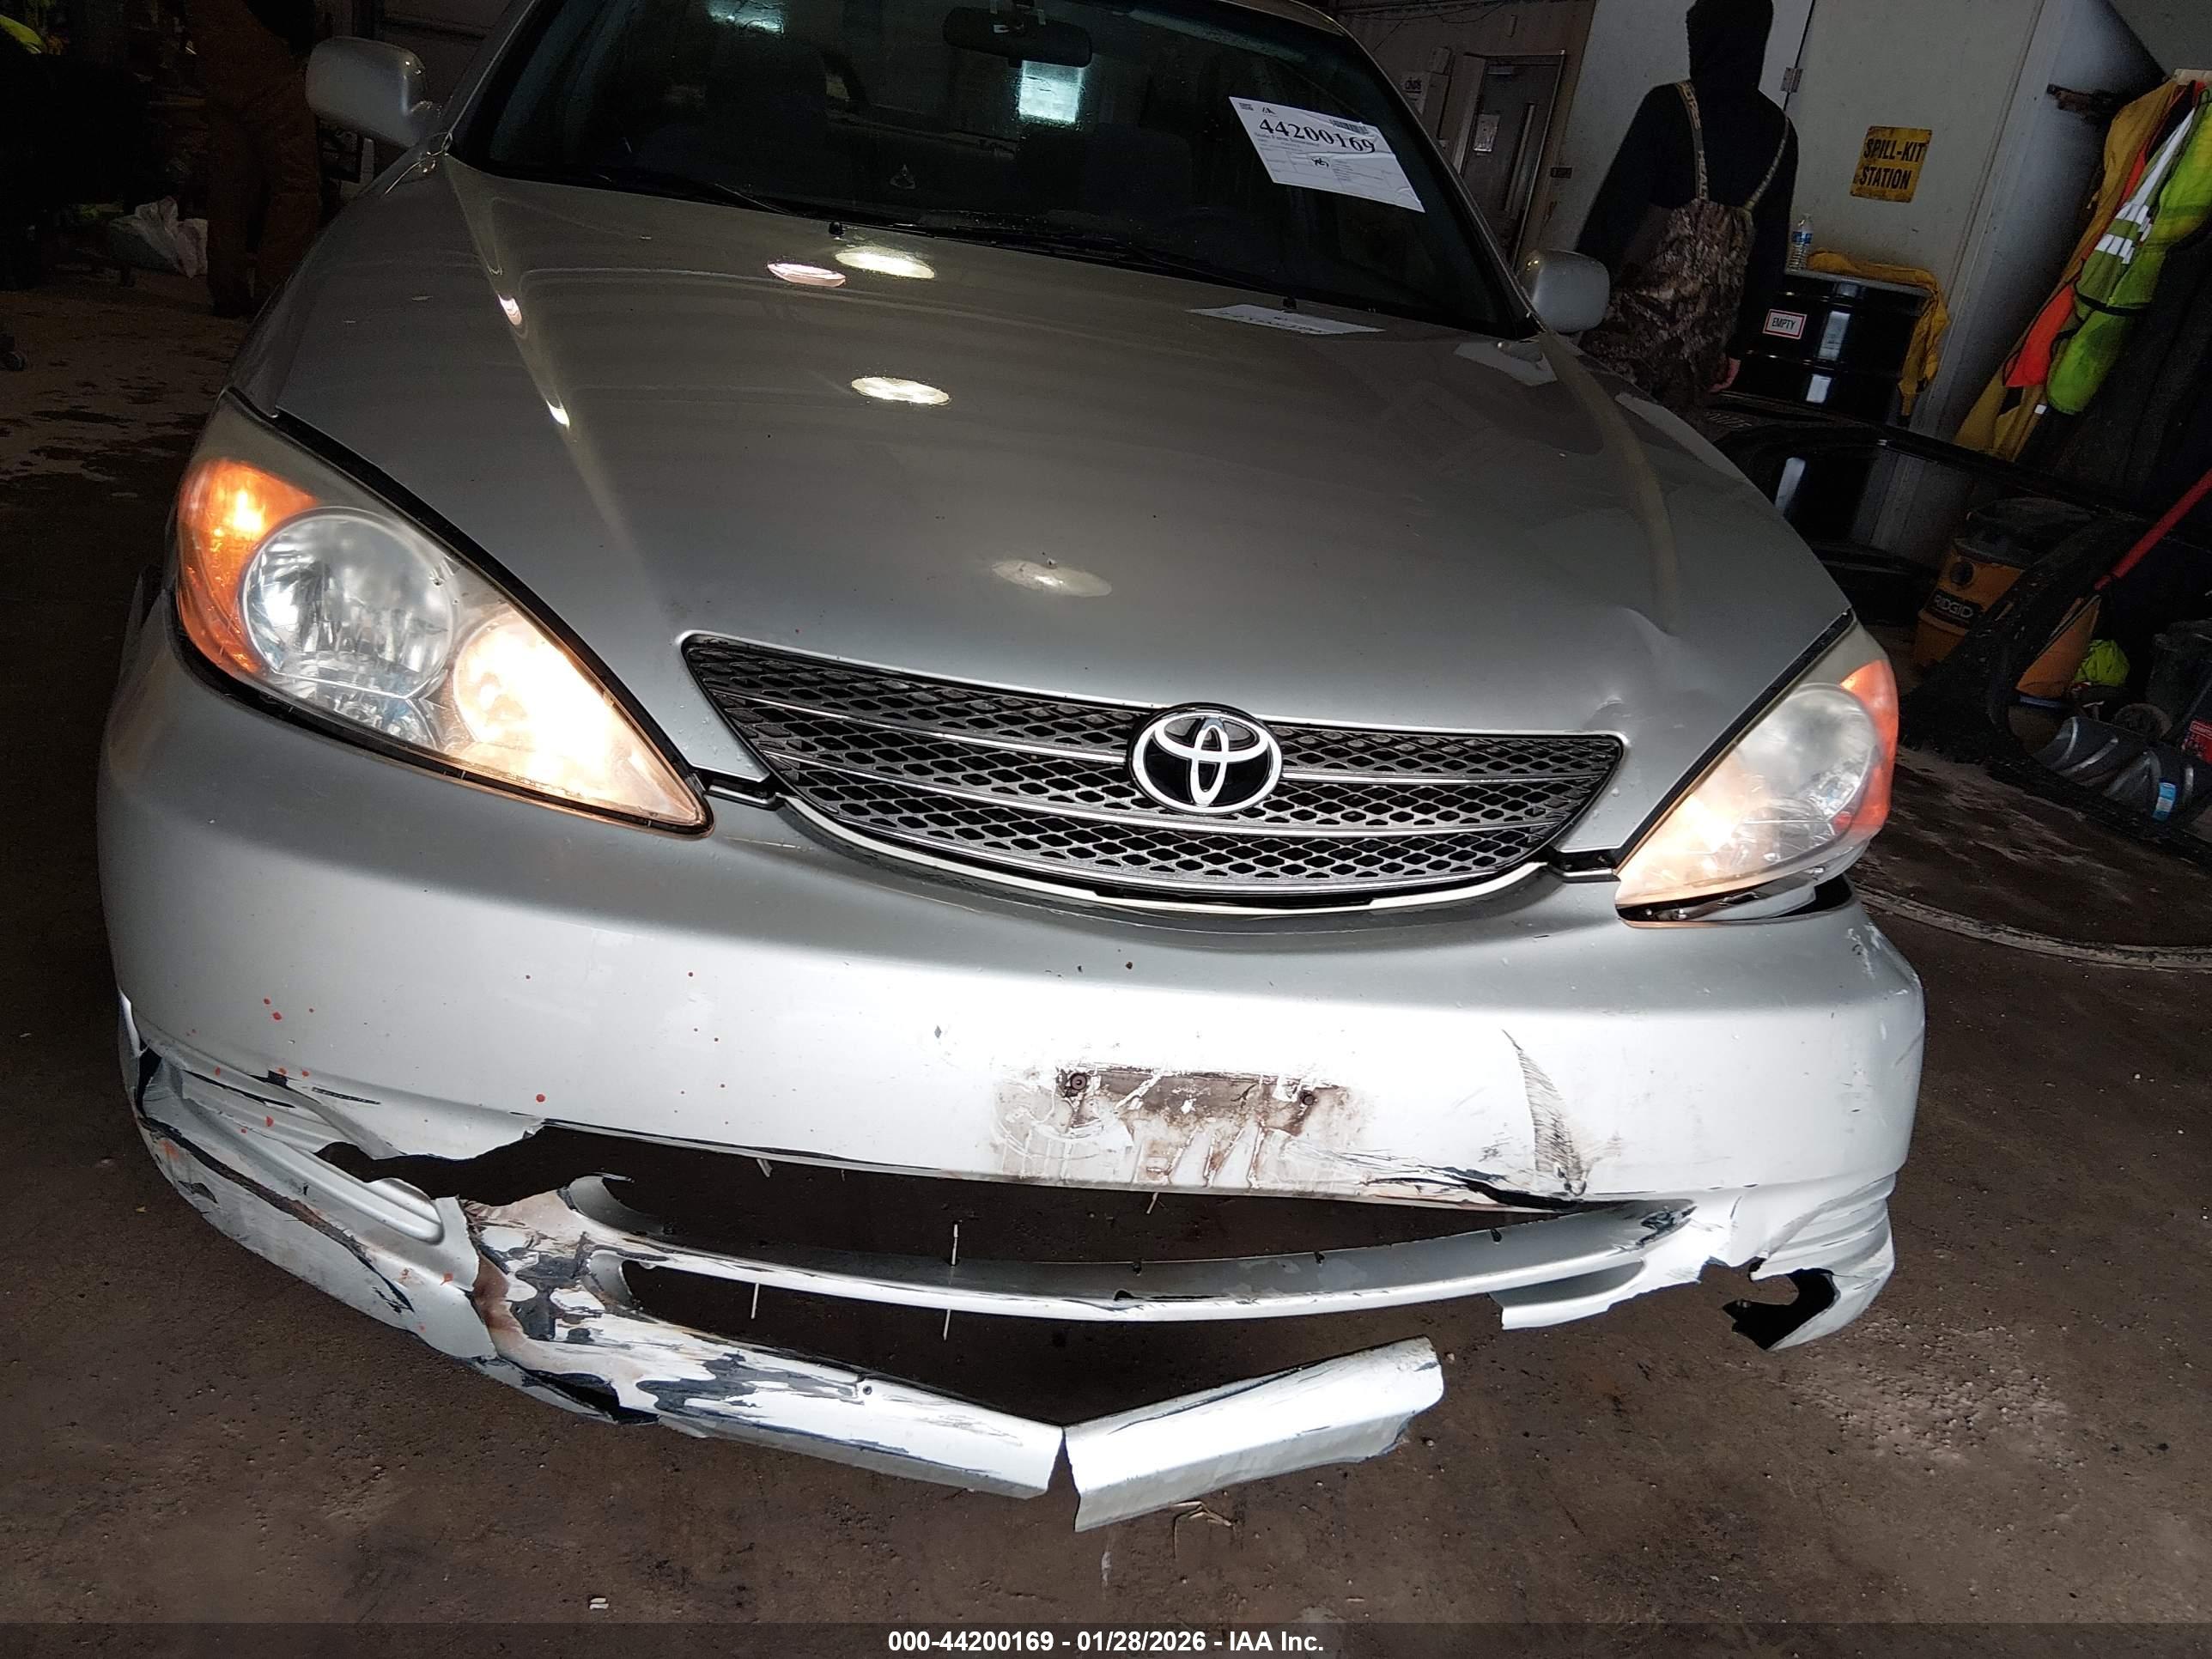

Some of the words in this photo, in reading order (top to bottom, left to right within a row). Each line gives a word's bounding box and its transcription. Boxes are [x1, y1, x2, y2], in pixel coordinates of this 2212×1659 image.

[1259, 118, 1376, 154] 44200169
[1863, 138, 1925, 162] SPILL-KIT
[1859, 167, 1911, 190] STATION
[1771, 317, 1796, 331] EMPTY
[1934, 593, 1974, 618] RIDGID
